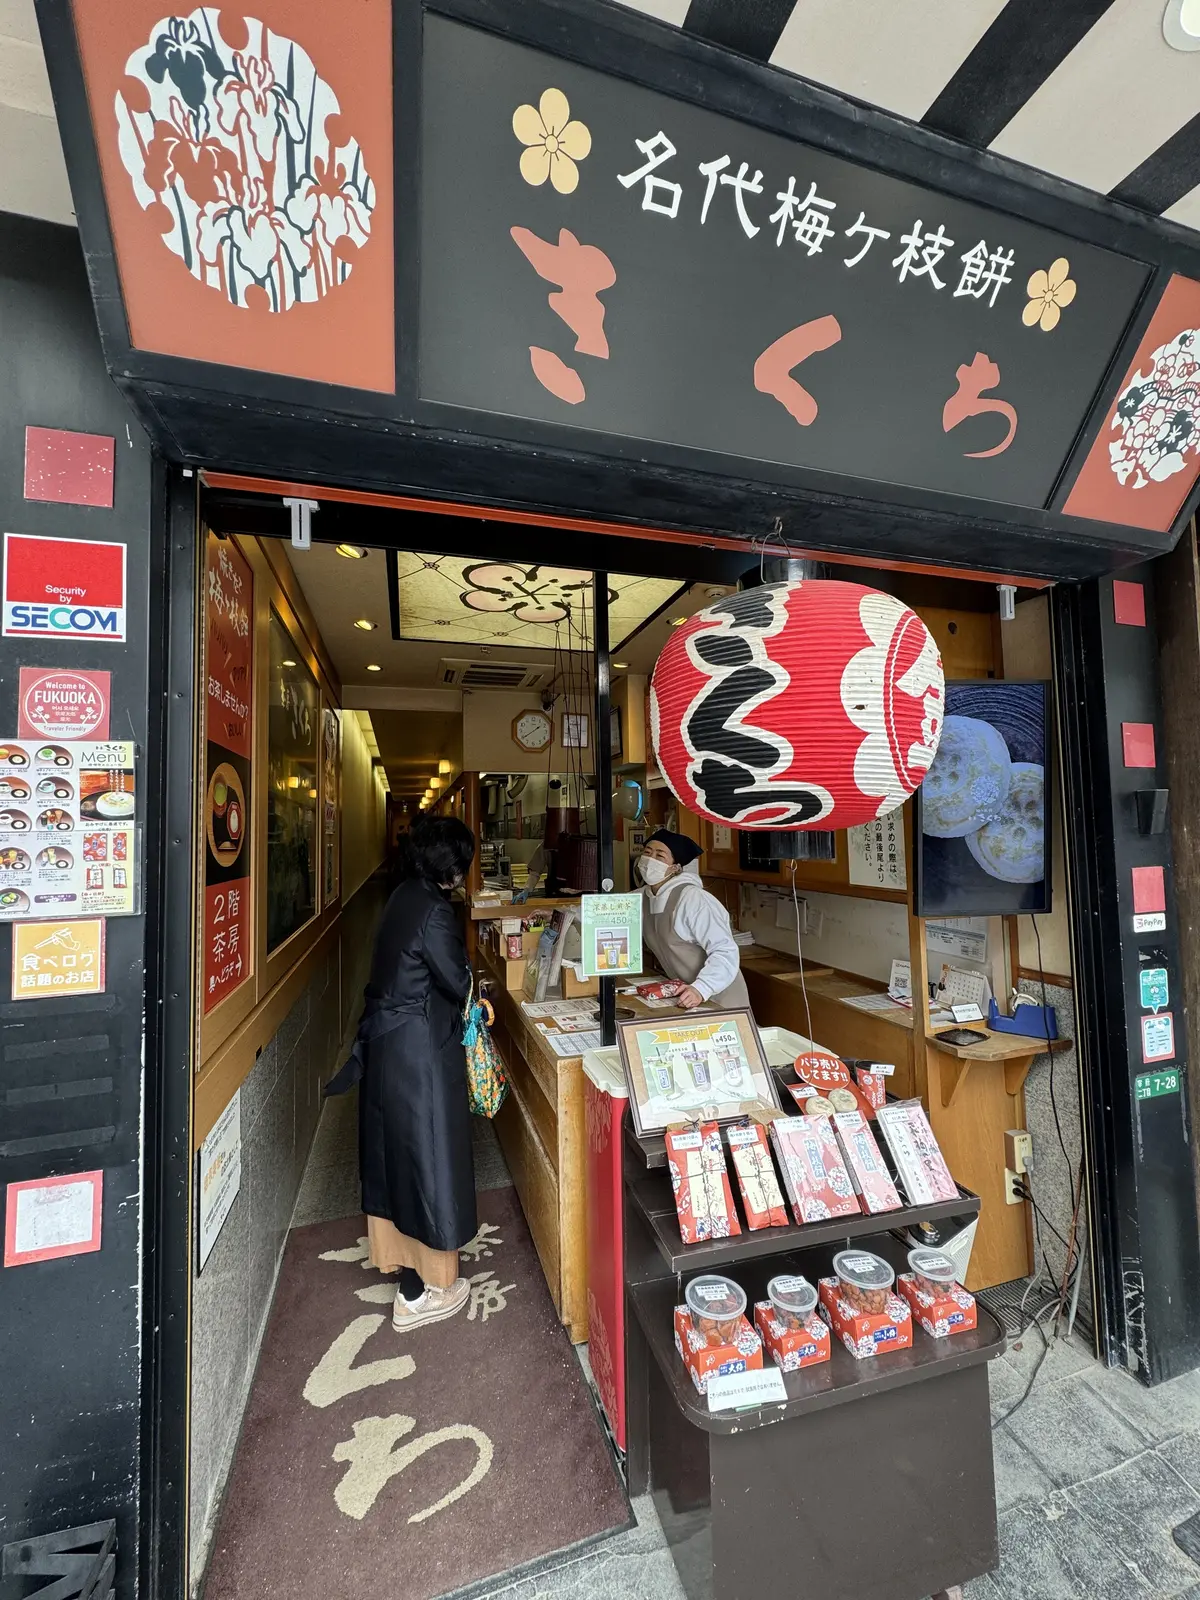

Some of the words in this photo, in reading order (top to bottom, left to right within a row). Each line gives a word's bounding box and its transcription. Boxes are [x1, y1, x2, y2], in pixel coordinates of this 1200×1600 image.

[510, 225, 1018, 459] きくち
[45, 584, 86, 596] Security
[59, 595, 72, 605] by
[11, 606, 117, 631] SECOM
[45, 681, 77, 690] Welcome
[79, 682, 86, 690] to
[34, 690, 97, 705] FUKUOKA
[81, 752, 127, 763] Menu
[213, 889, 240, 924] 2階
[1143, 918, 1163, 927] PayPay
[212, 924, 240, 963] 茶房
[21, 950, 97, 972] 食べログ
[20, 970, 95, 989] 話題のお店
[1154, 1076, 1176, 1091] 7-28
